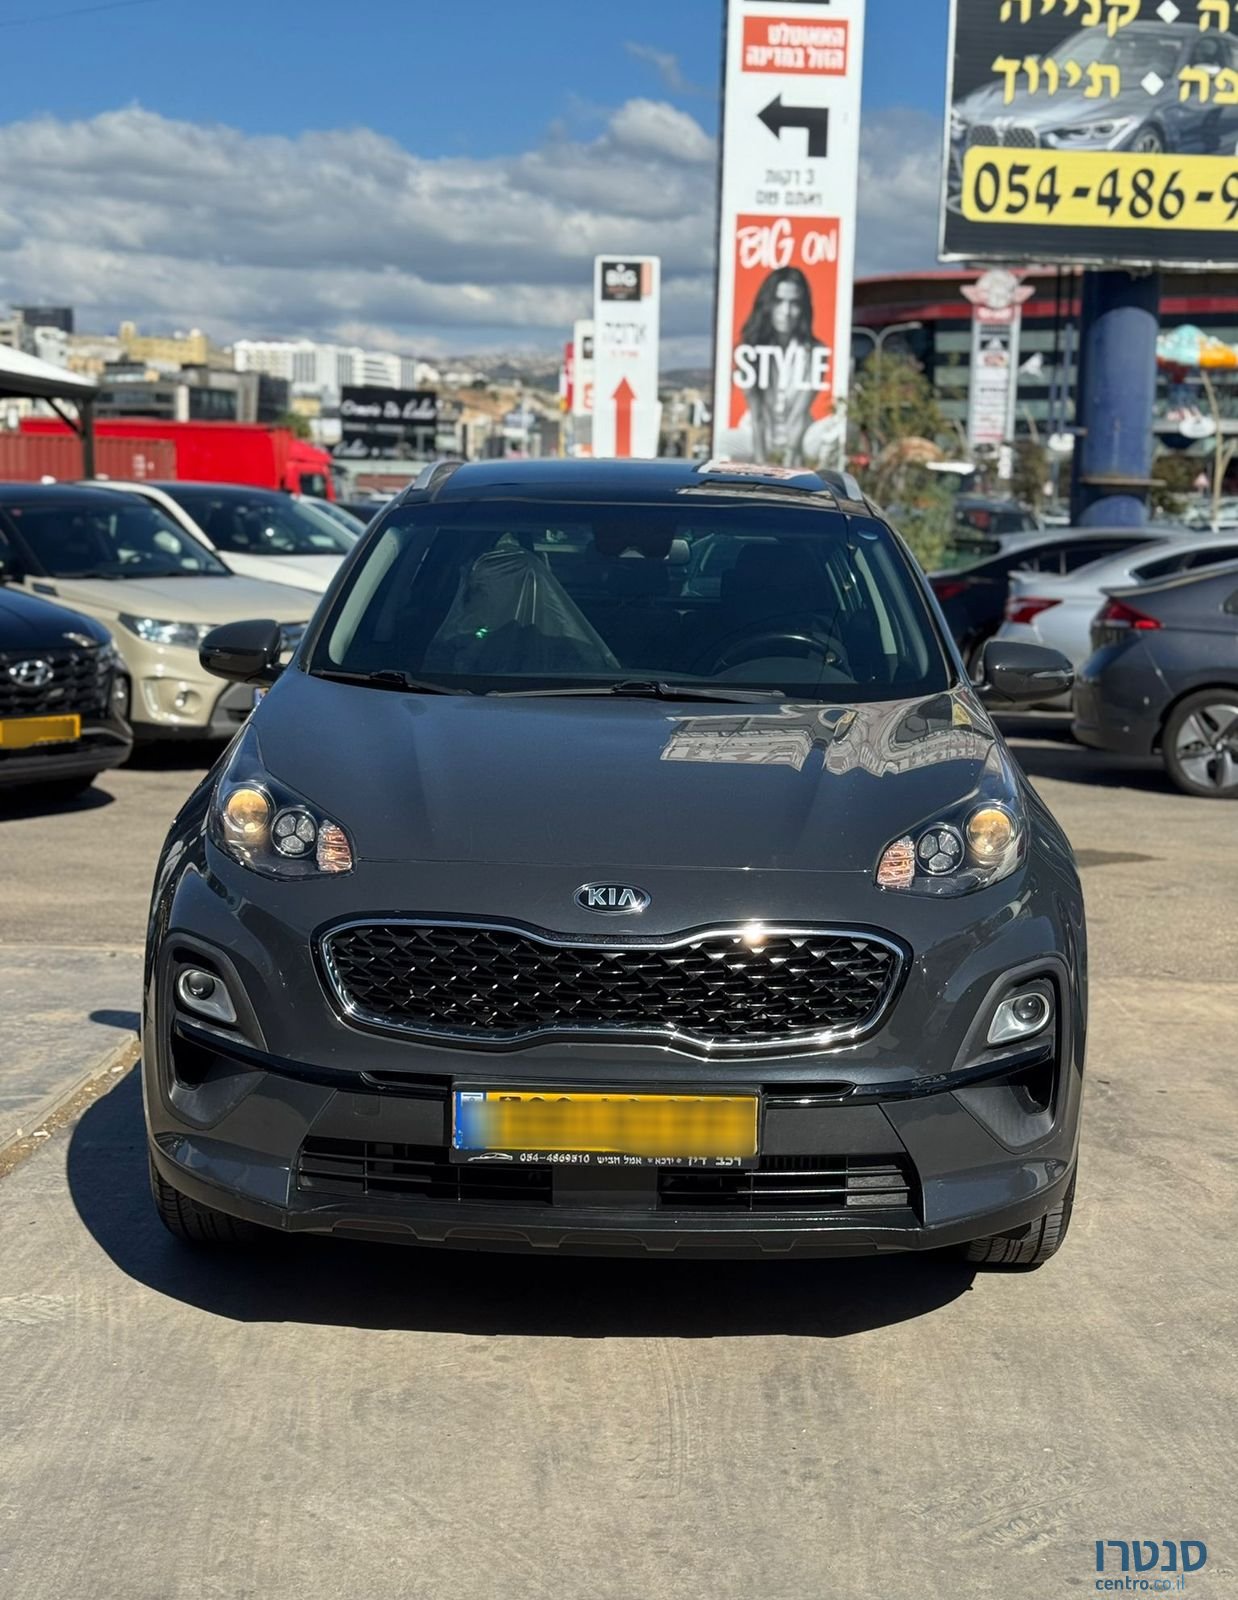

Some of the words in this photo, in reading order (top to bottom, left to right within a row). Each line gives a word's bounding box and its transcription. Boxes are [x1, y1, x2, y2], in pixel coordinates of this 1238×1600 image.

[1000, 0, 1141, 38] קנייה
[745, 45, 805, 69] במדינה
[806, 46, 844, 70] הזול
[991, 55, 1120, 105] תיווך
[736, 217, 795, 270] BIG
[802, 229, 838, 266] ON
[733, 339, 832, 391] STYLE
[588, 887, 638, 906] KIA
[715, 1156, 741, 1166] רכב
